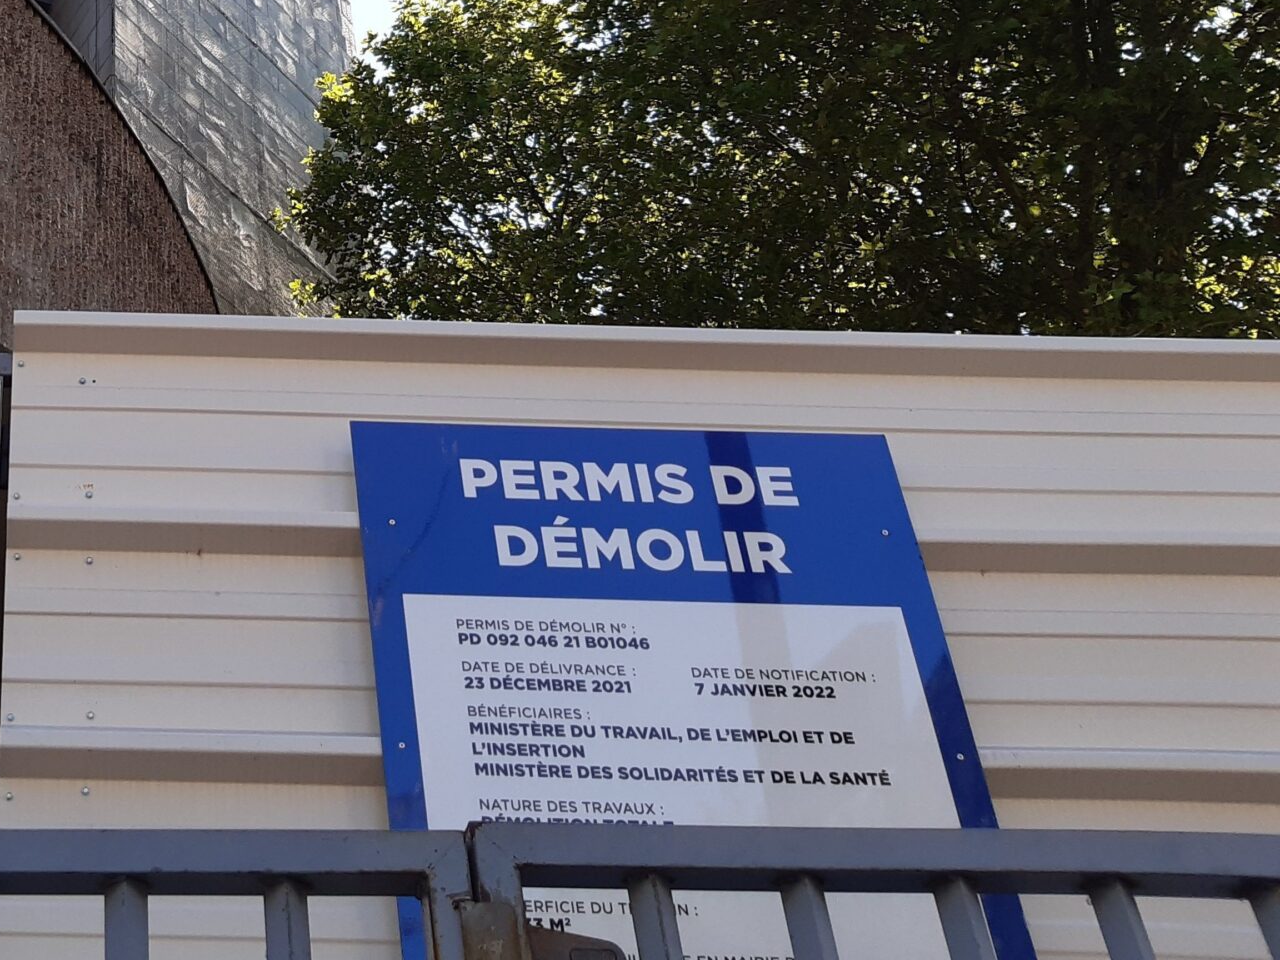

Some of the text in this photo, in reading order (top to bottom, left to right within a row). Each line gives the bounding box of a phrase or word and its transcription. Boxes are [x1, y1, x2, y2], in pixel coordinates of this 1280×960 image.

[459, 458, 800, 506] PERMIS DE
[493, 515, 793, 574] DÉMOLIR
[456, 619, 510, 631] PERMIS
[514, 620, 534, 631] DE
[539, 619, 605, 633] DÉMOLIR
[458, 633, 650, 650] PD 092 046 21 B01046
[461, 661, 500, 673] DATE
[505, 662, 525, 673] DE
[529, 660, 626, 676] DÉLIVRANCE
[691, 667, 730, 679] DATE
[734, 669, 756, 680] DE
[760, 669, 867, 682] NOTIFICATION
[464, 674, 632, 693] 23 DÉCEMBRE 2021
[694, 683, 837, 699] 7 JANVIER 2022
[467, 703, 582, 720] BÉNÉFICIAIRES
[469, 721, 855, 745] MINISTÈRE DU TRAVAIL, DE L'EMPLOI ET DE
[472, 741, 586, 759] L'INSERTION
[474, 761, 891, 786] MINISTÈRE DES SOLIDARITÉS ET DE LA SANTÉ
[479, 798, 543, 812] NATURE
[547, 800, 578, 813] DES
[582, 801, 656, 815] TRAVAUX
[590, 901, 614, 915] DU
